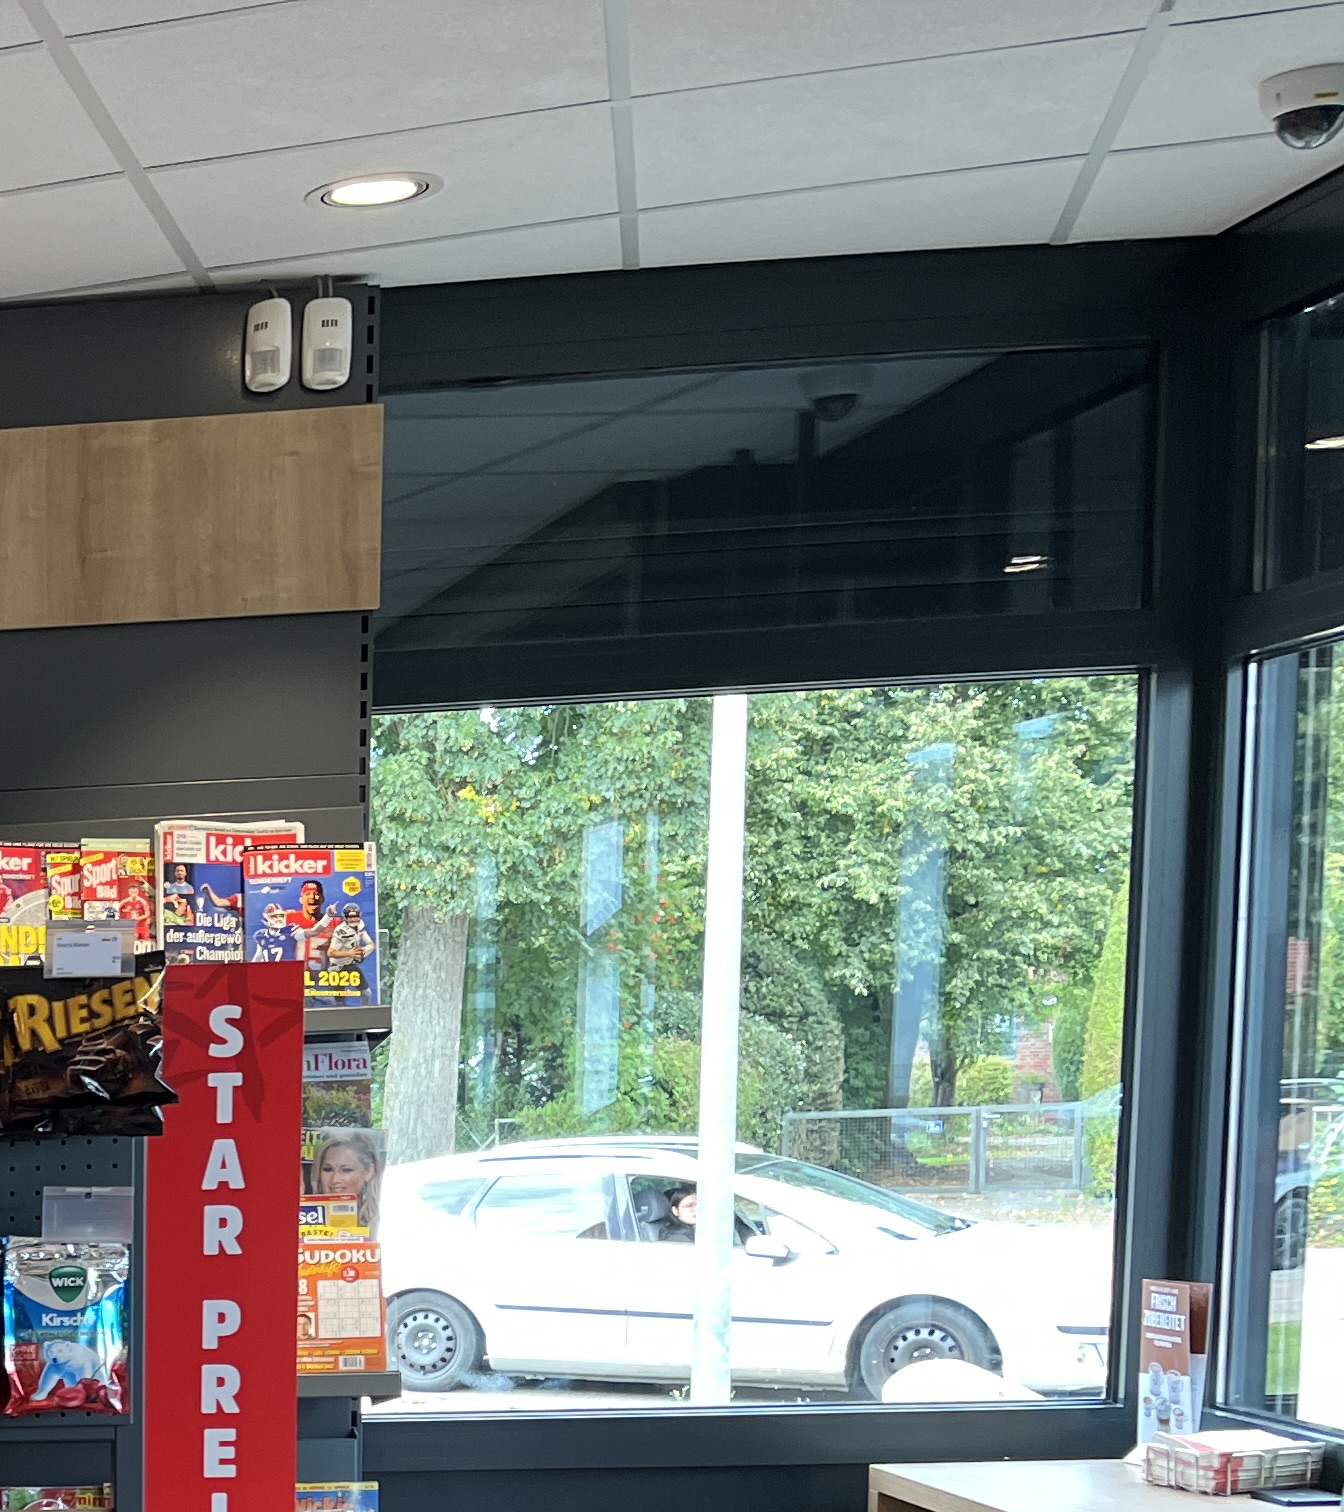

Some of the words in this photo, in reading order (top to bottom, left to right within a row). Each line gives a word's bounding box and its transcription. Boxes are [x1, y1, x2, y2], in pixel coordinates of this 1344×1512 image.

[257, 854, 327, 874] kicker
[83, 858, 117, 888] Sport
[96, 885, 117, 899] Bild
[196, 912, 212, 926] Die
[214, 913, 237, 930] Liga
[166, 929, 184, 943] der
[318, 971, 361, 986] 2026
[10, 973, 162, 1053] RIESEN
[201, 1005, 246, 1257] STAR
[299, 1248, 381, 1264] SUDOKU
[51, 1276, 84, 1288] WICK
